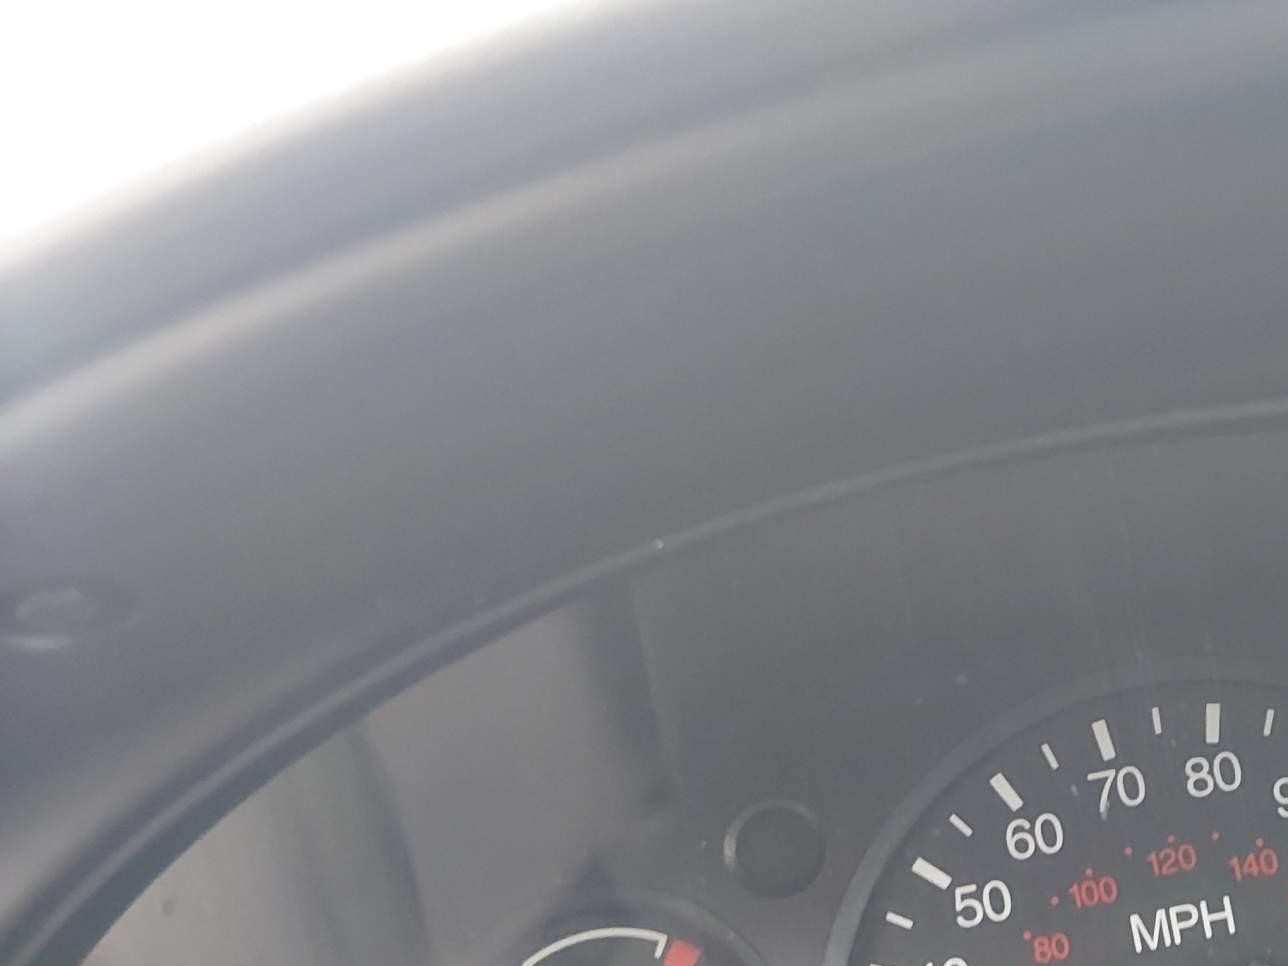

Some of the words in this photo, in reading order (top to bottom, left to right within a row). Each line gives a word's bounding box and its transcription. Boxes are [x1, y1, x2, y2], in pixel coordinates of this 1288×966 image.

[1087, 766, 1146, 814] 70
[1185, 751, 1242, 798] 80
[1005, 813, 1064, 860] 60
[1146, 844, 1197, 877] 120
[1229, 851, 1279, 881] 140
[954, 880, 1012, 928] 50
[1068, 876, 1118, 910] 100
[1033, 932, 1070, 964] 80
[1129, 895, 1236, 954] MPH
